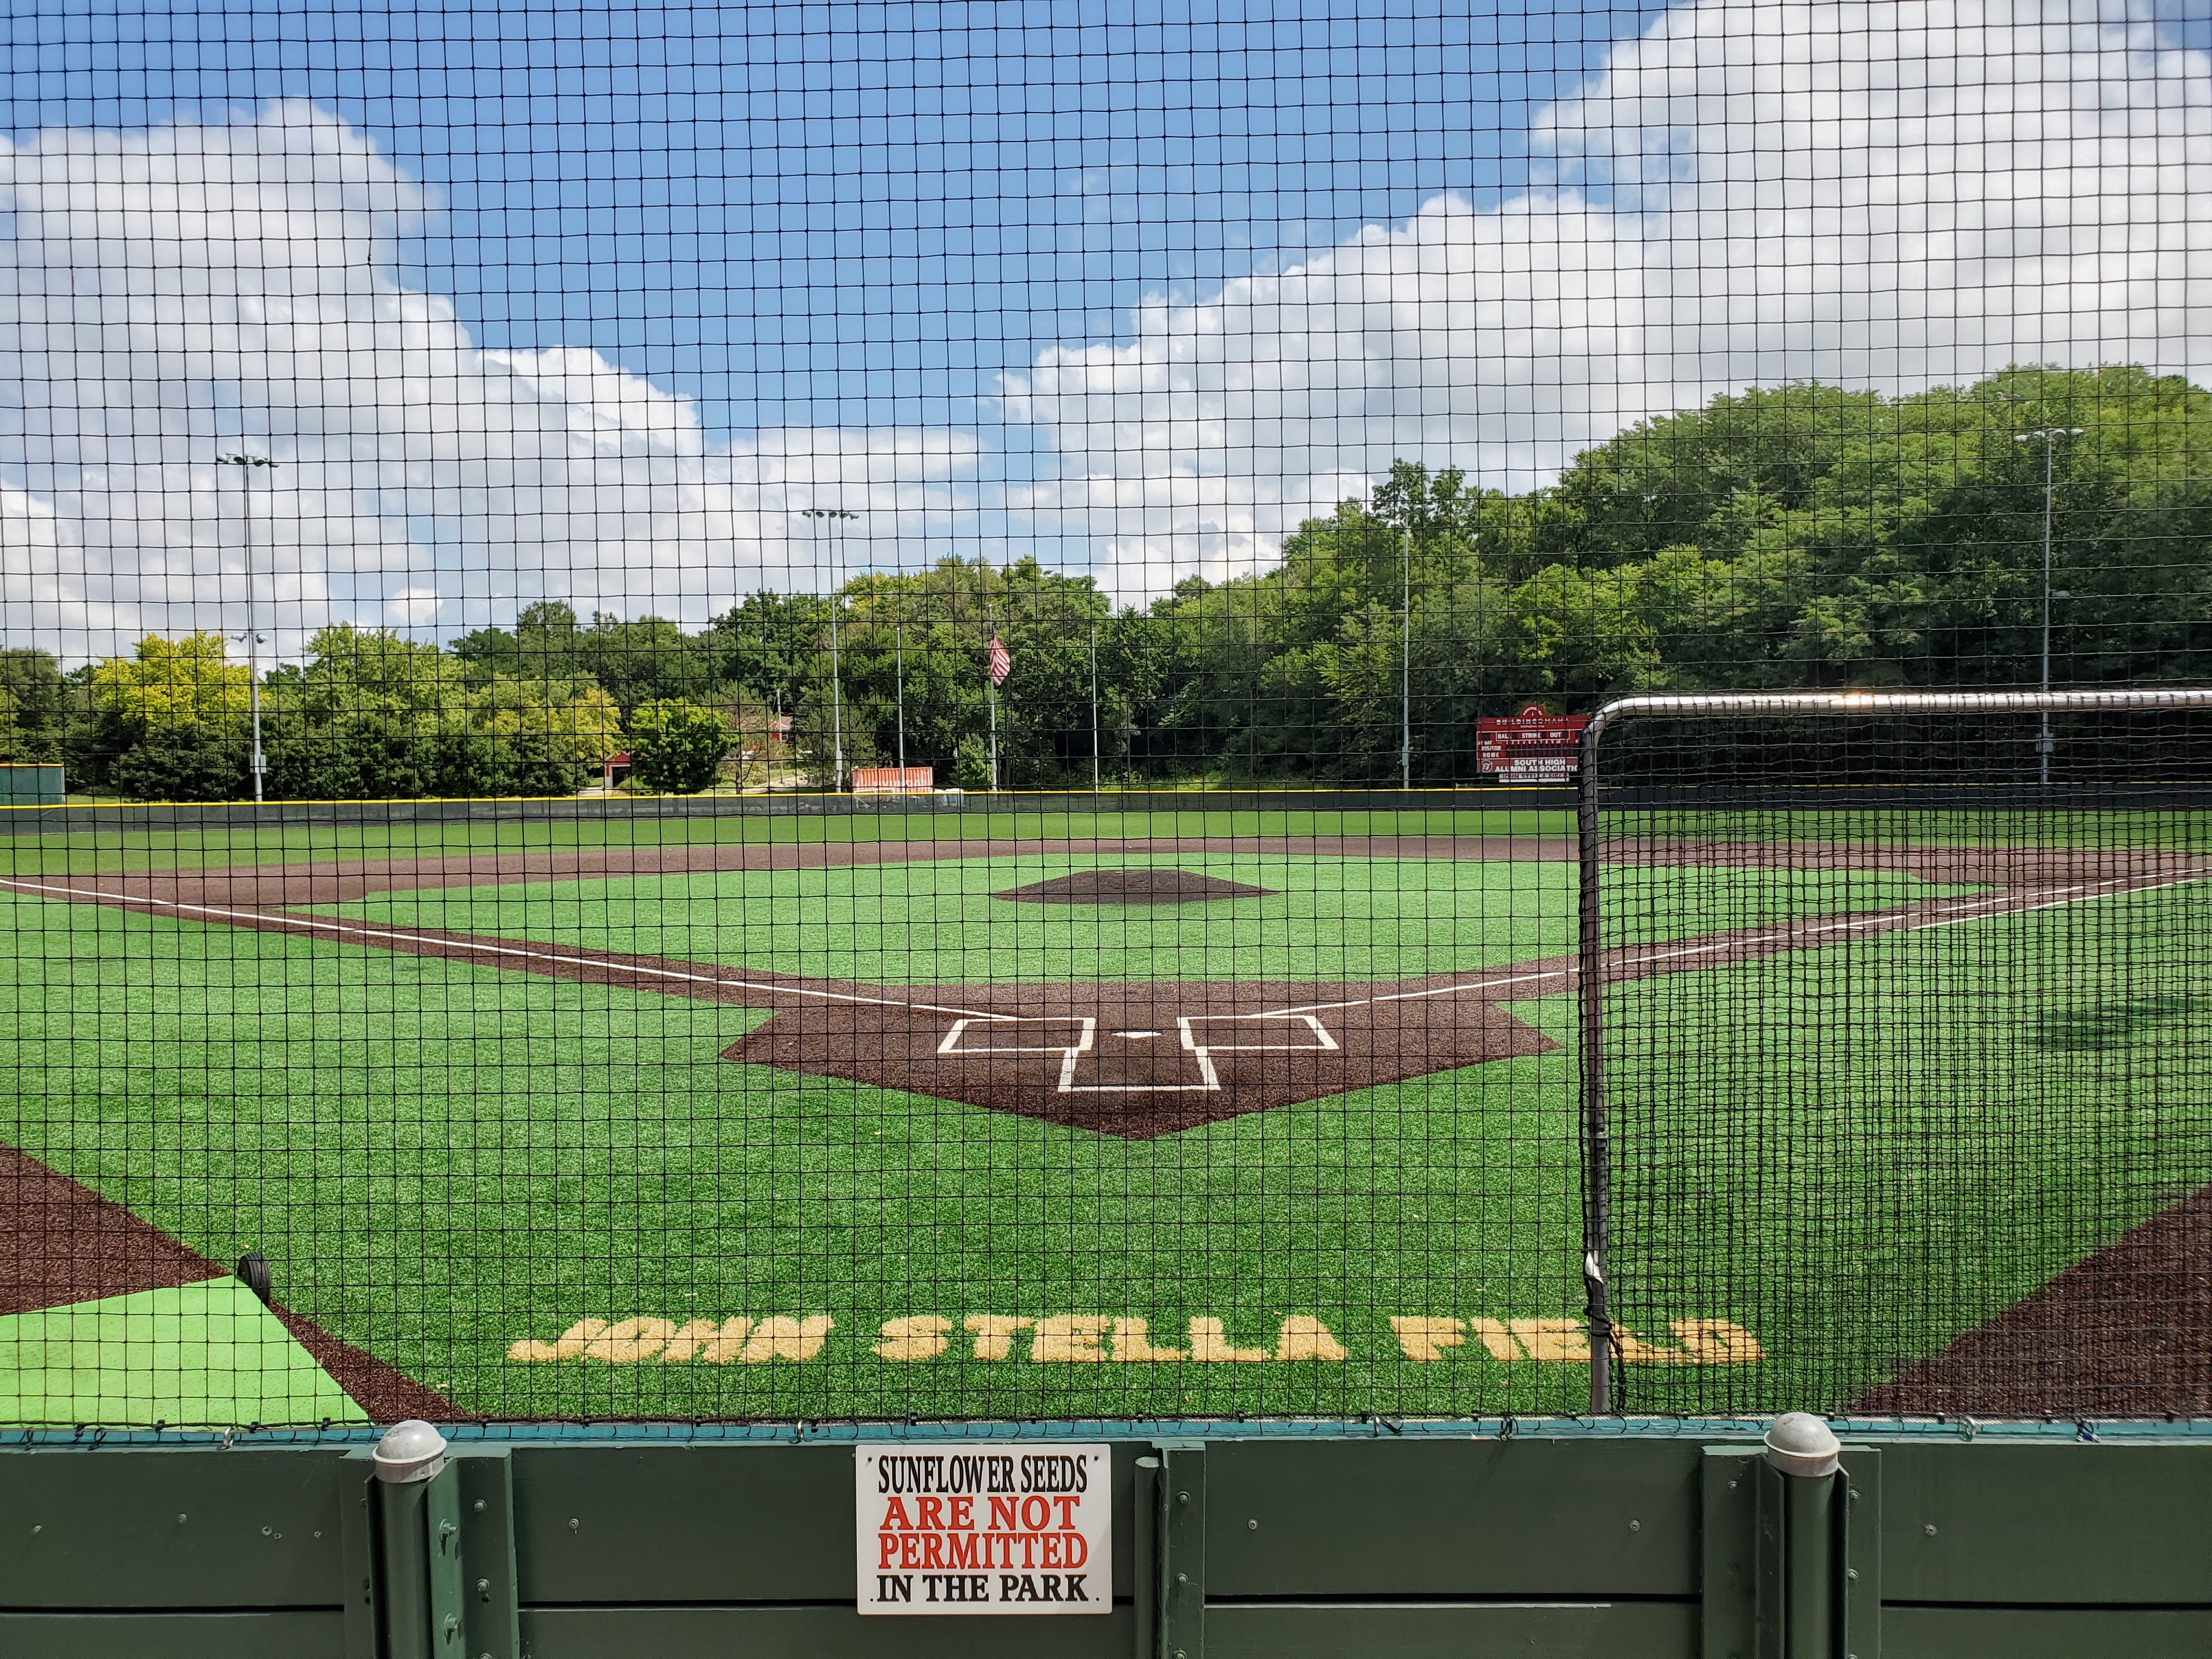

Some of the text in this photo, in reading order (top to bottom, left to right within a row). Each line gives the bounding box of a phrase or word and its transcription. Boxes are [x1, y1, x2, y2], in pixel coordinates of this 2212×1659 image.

[872, 1313, 1347, 1362] STELLA
[1390, 1316, 1767, 1363] FIELD
[878, 1454, 1087, 1493] SUNFLOWER SEEDS
[879, 1496, 1080, 1531] ARE NOT
[878, 1532, 1088, 1570] PERMITTED
[877, 1575, 1089, 1602] IN THE PARK
